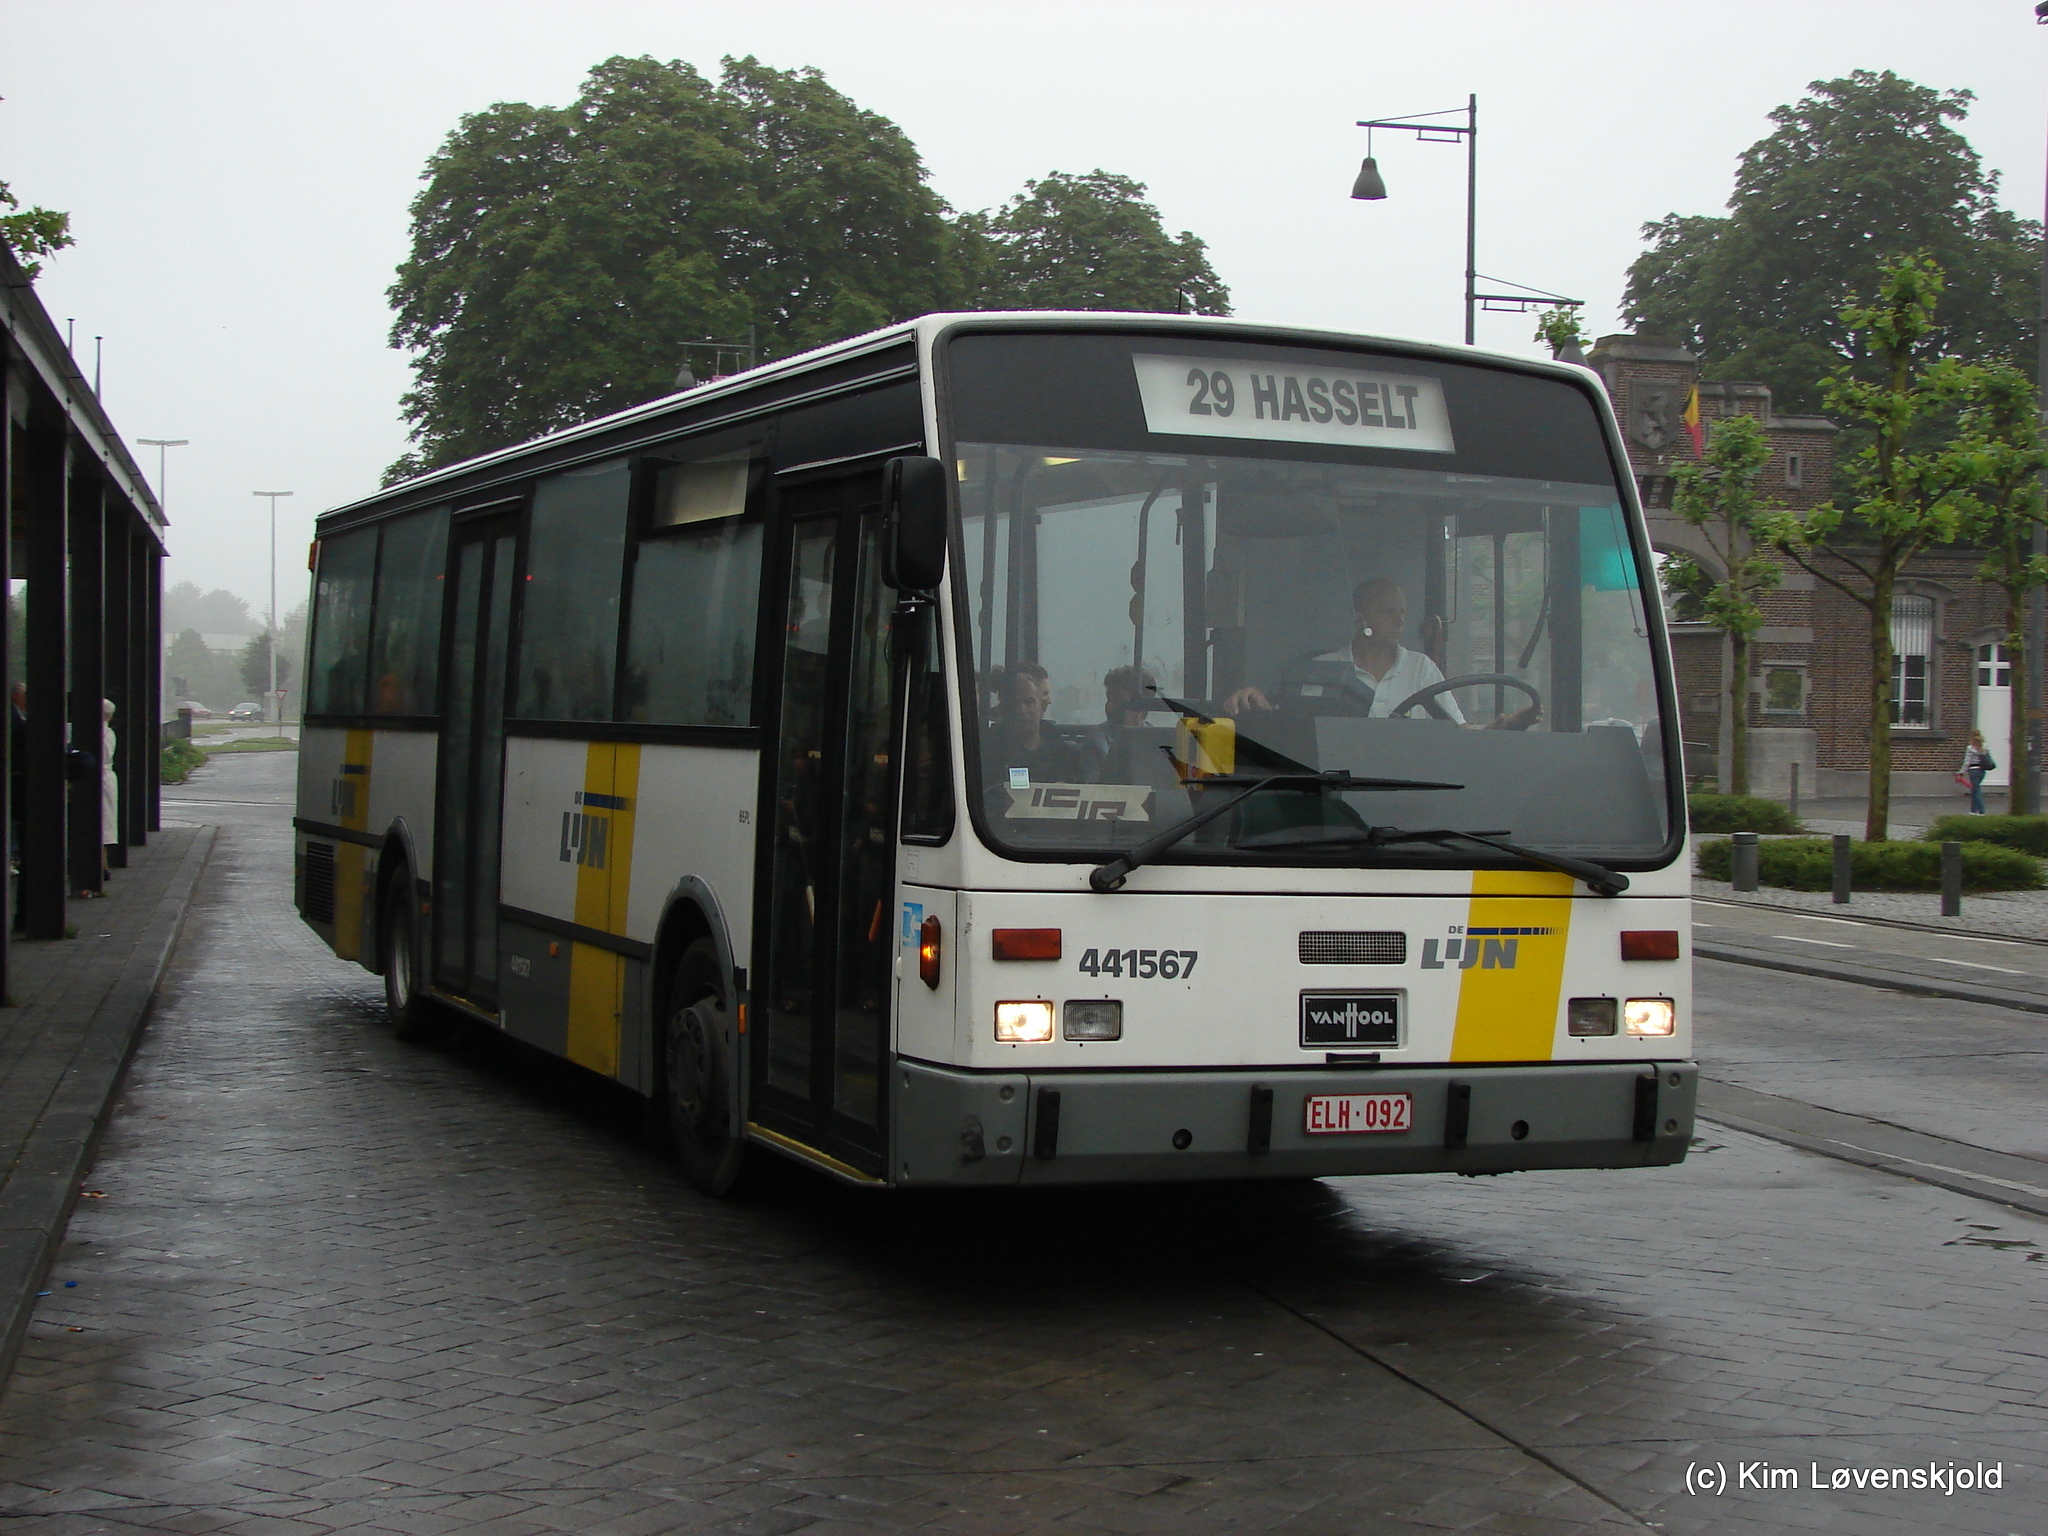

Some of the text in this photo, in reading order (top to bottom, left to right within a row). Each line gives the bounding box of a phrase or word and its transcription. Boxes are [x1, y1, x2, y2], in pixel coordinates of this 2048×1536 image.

[1186, 368, 1418, 430] 29 HASSELT
[559, 811, 608, 870] LIJN
[1448, 926, 1464, 934] DE
[1078, 948, 1198, 979] 441567
[1420, 938, 1518, 969] LIJN
